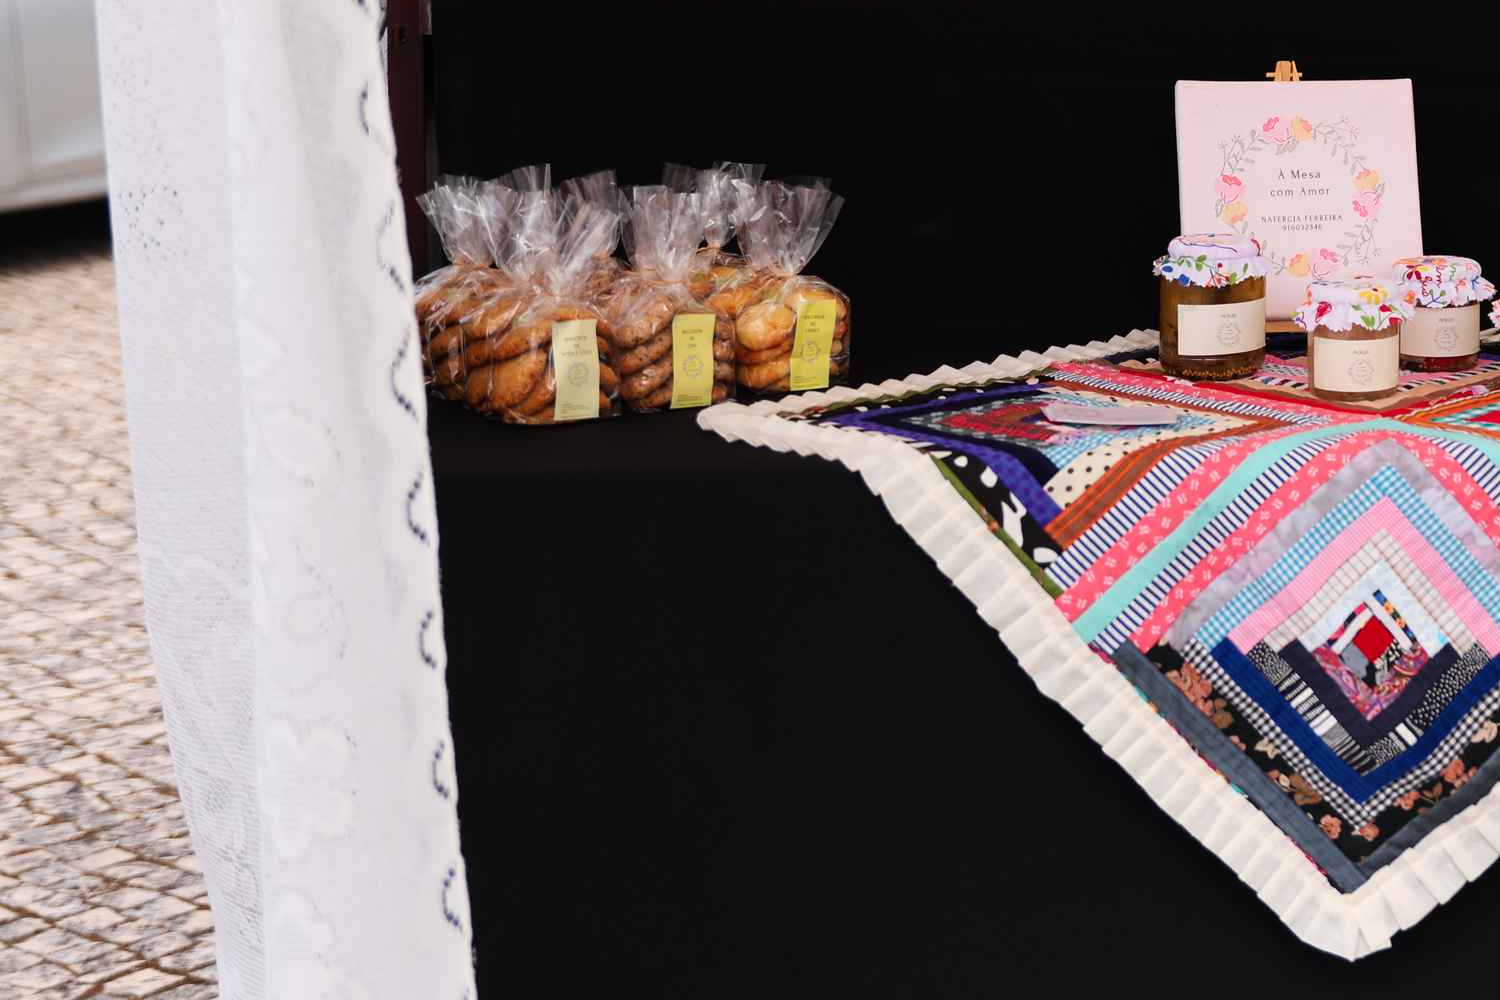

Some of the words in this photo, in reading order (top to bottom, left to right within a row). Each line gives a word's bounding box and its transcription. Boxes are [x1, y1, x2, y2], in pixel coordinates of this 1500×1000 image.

[1291, 169, 1321, 181] Mesa
[1270, 189, 1294, 197] com
[1299, 187, 1330, 197] Amor
